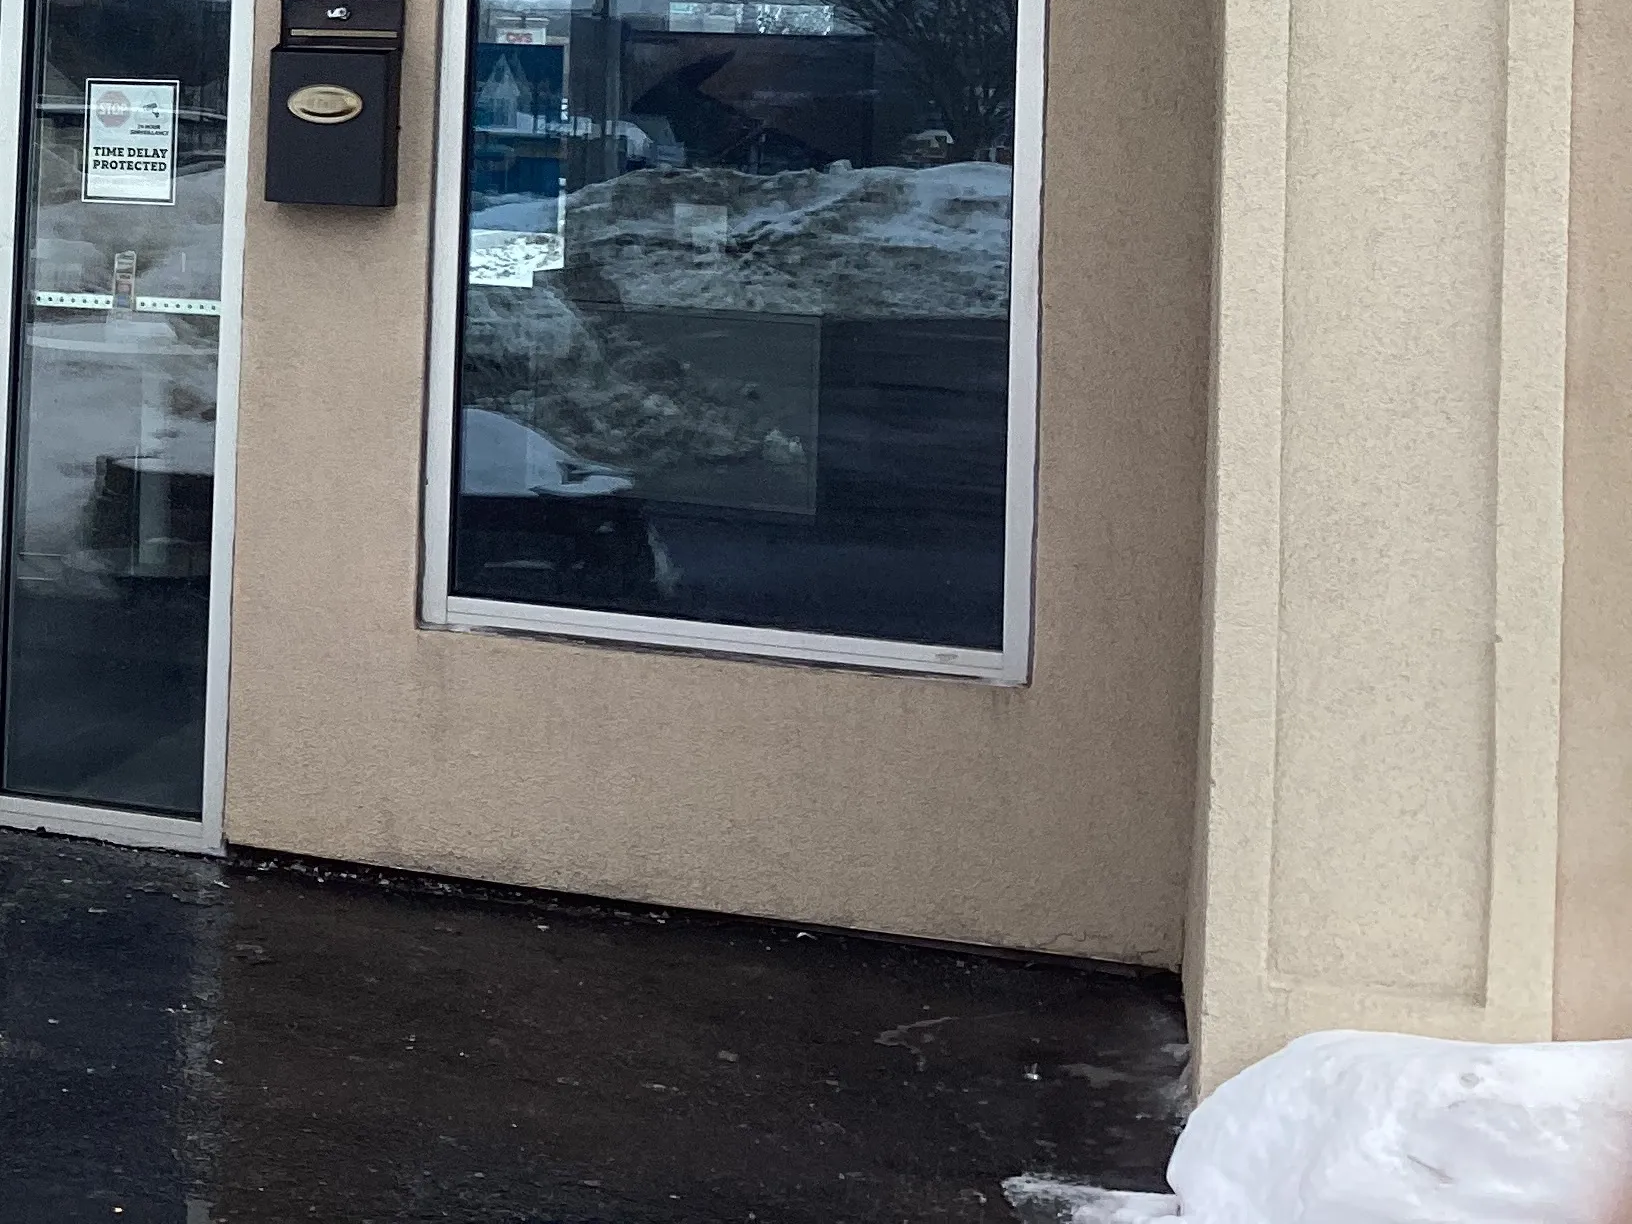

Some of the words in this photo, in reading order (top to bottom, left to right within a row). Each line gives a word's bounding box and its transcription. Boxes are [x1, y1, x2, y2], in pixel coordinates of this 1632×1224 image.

[92, 146, 125, 158] TIME
[127, 147, 169, 159] DELAY
[92, 159, 167, 172] PROTECTED
